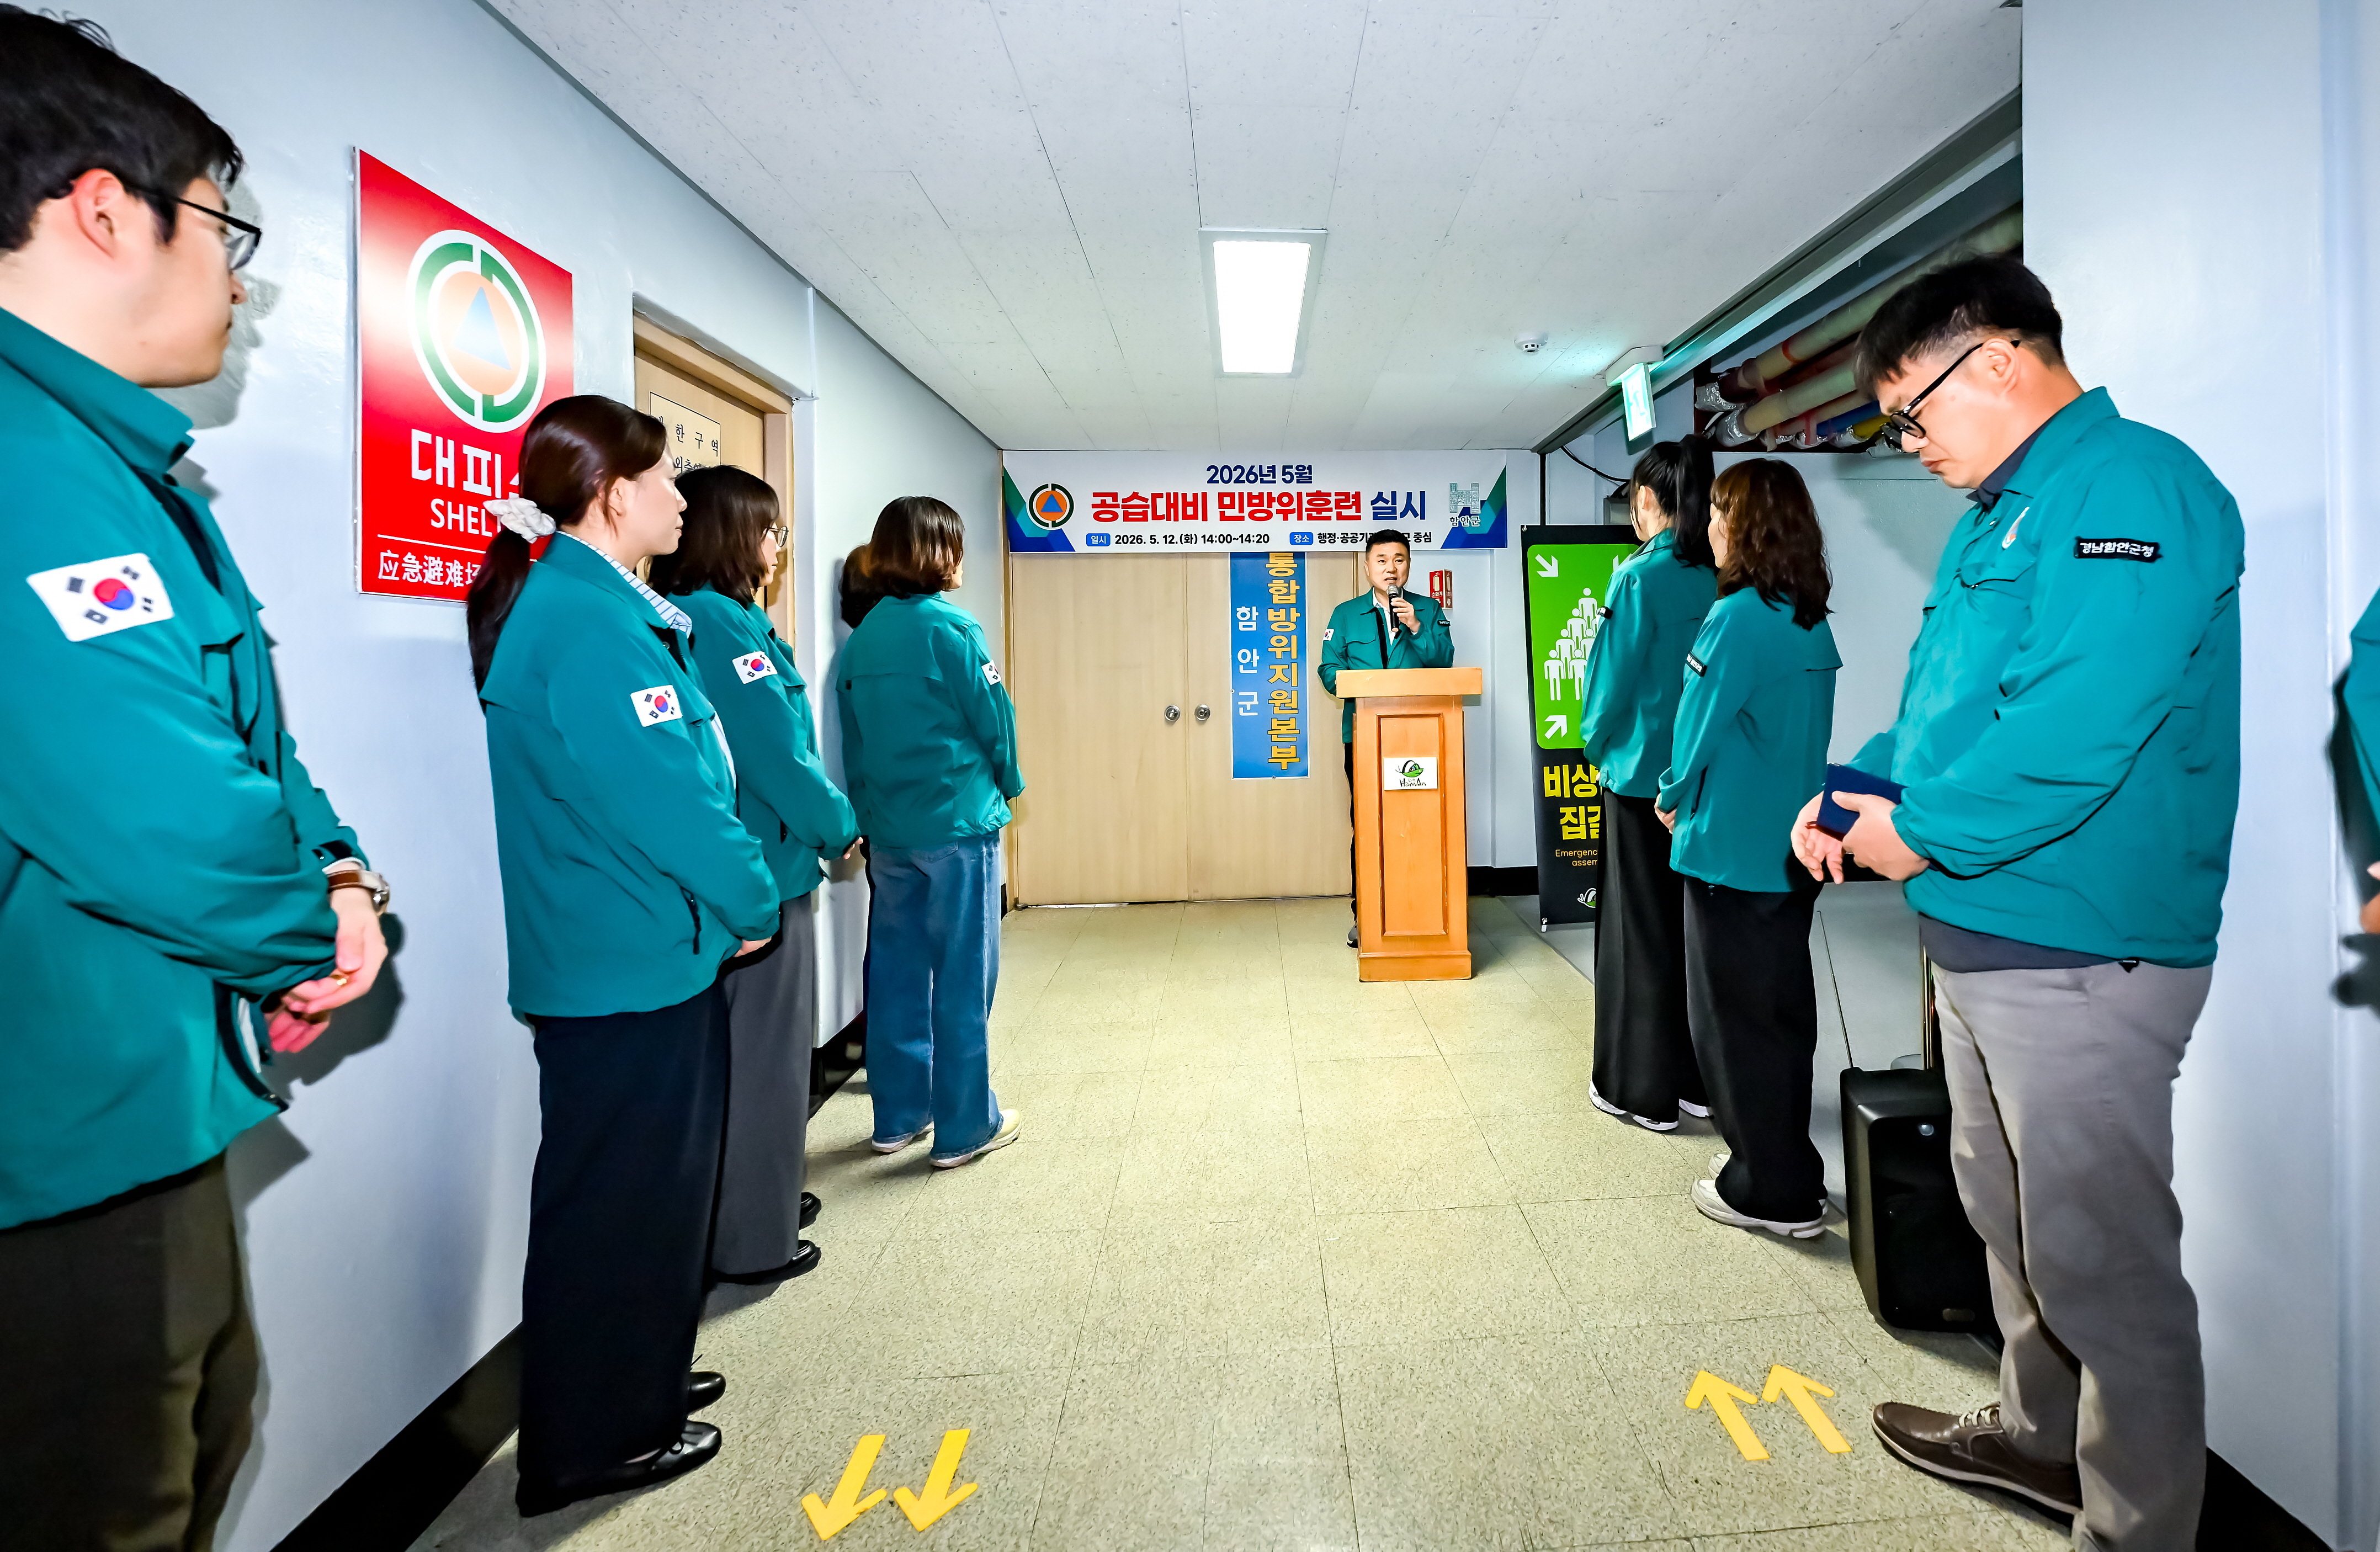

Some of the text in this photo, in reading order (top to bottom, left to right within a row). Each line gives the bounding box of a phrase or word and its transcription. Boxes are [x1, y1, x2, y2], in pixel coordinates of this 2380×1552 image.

[1206, 464, 1313, 484] 2026년 5월
[1091, 490, 1426, 522] 공습대비 민방위훈련 실시
[431, 498, 501, 537] SHEL
[1449, 516, 1480, 527] 함안군
[1091, 535, 1107, 544] 일시
[1115, 534, 1146, 544] 2026.
[1150, 534, 1160, 544] 5.
[1201, 534, 1270, 544] 14:00~14:20
[1293, 535, 1310, 543] 장소
[1413, 532, 1432, 543] 중심
[2080, 542, 2154, 557] 경남함안군청
[1543, 764, 1602, 798] 비상
[1555, 849, 1598, 858] Emergenc
